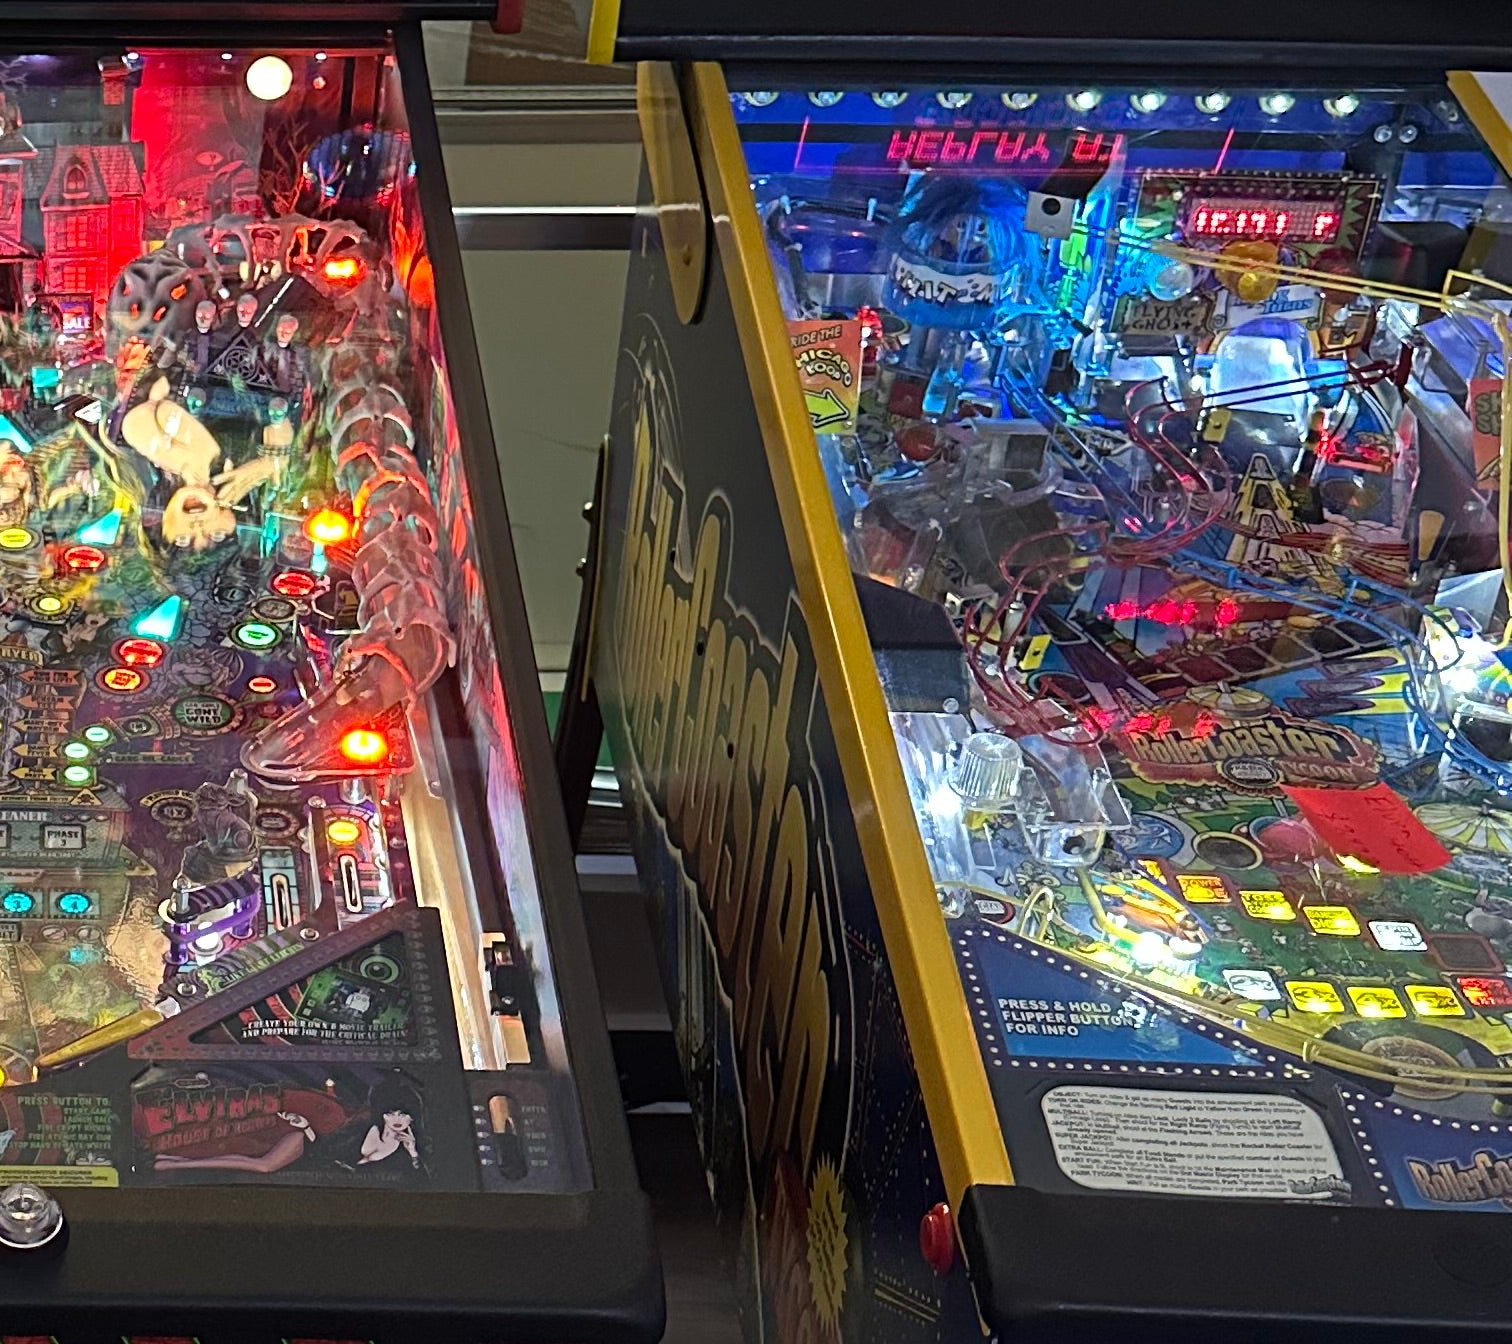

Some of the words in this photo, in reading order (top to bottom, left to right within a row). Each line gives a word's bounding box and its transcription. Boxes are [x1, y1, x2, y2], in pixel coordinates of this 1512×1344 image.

[819, 324, 843, 341] THE
[796, 348, 854, 387] HICAGO
[1131, 718, 1343, 765] RollerCoaster
[46, 829, 79, 839] PHASE
[998, 998, 1050, 1011] PRESS
[1053, 1002, 1065, 1012] &
[1069, 1002, 1112, 1014] HOLD
[1001, 1010, 1067, 1024] FLIPPER
[1005, 1022, 1039, 1035] FOR
[1041, 1024, 1079, 1037] INFO
[17, 1095, 50, 1106] PRESS
[52, 1095, 93, 1106] BUTTON
